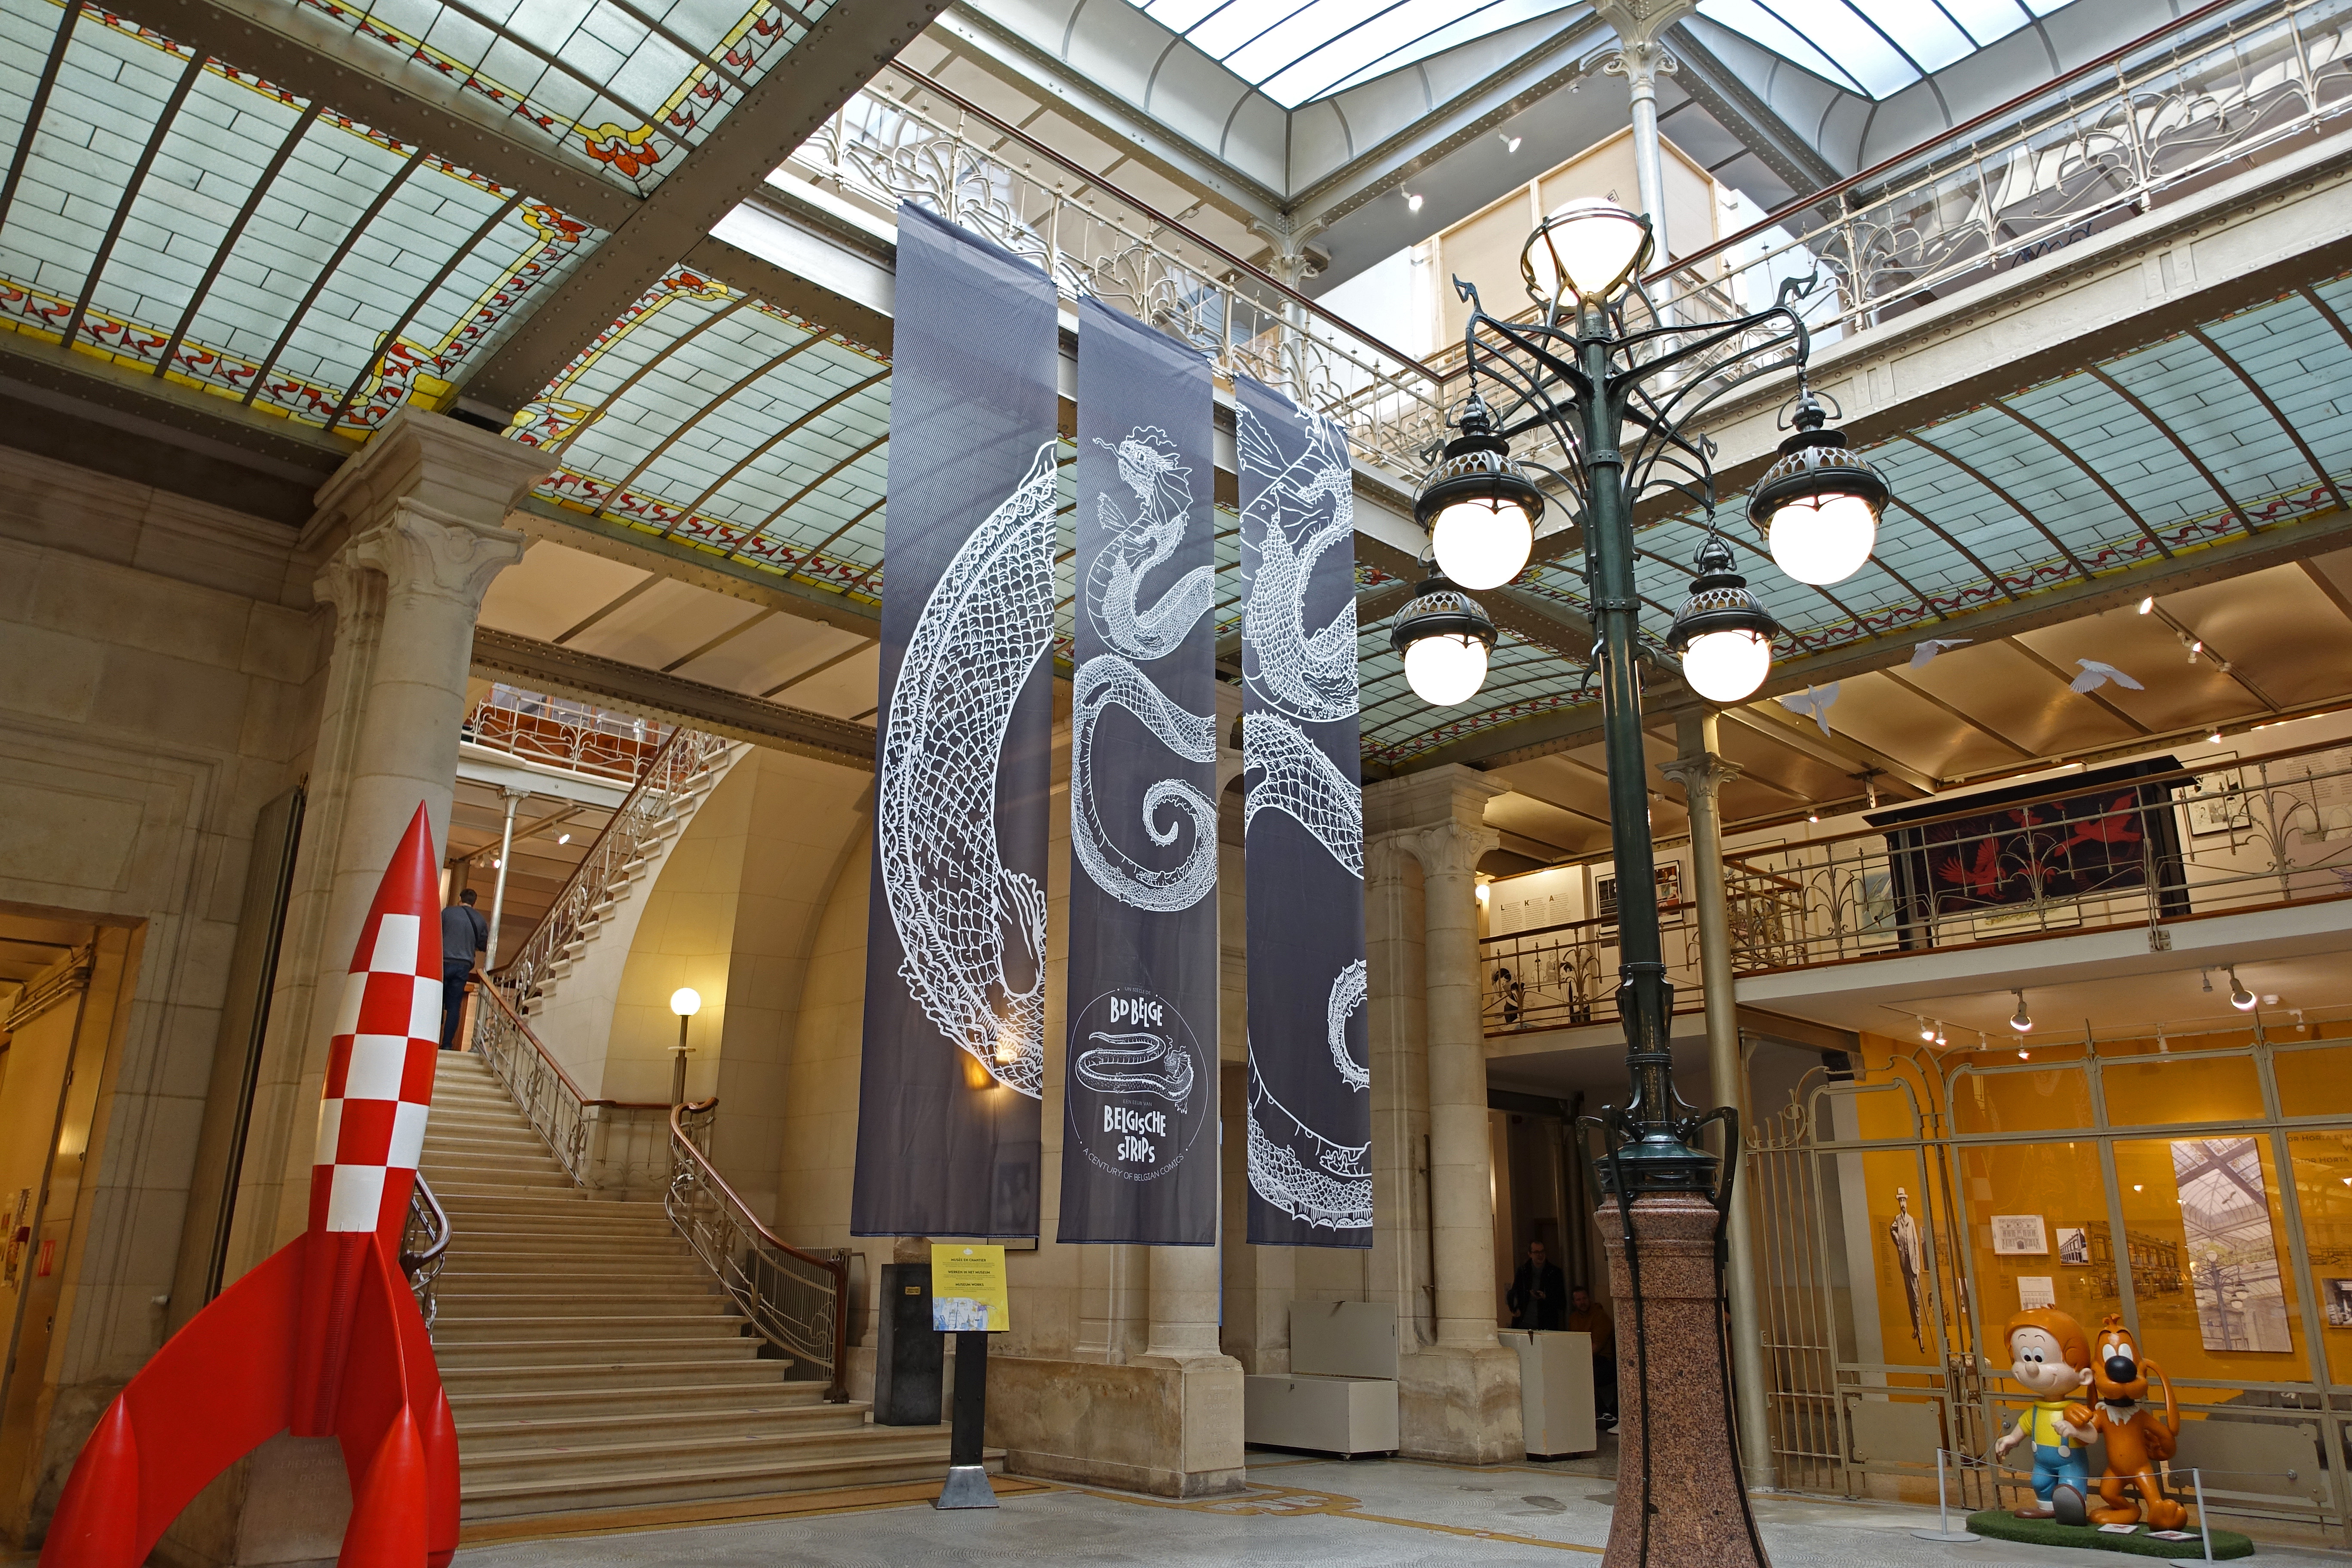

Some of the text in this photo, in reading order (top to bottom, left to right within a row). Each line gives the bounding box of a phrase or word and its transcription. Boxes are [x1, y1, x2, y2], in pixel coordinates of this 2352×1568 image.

[1111, 996, 1162, 1027] BD BELGE
[1104, 1105, 1166, 1137] BELGISCHE
[1118, 1136, 1155, 1163] STRIPS
[1088, 1153, 1123, 1177] CENTURY
[1124, 1172, 1133, 1180] OF
[1134, 1170, 1160, 1181] BELGIAN
[1160, 1153, 1184, 1175] COMICS
